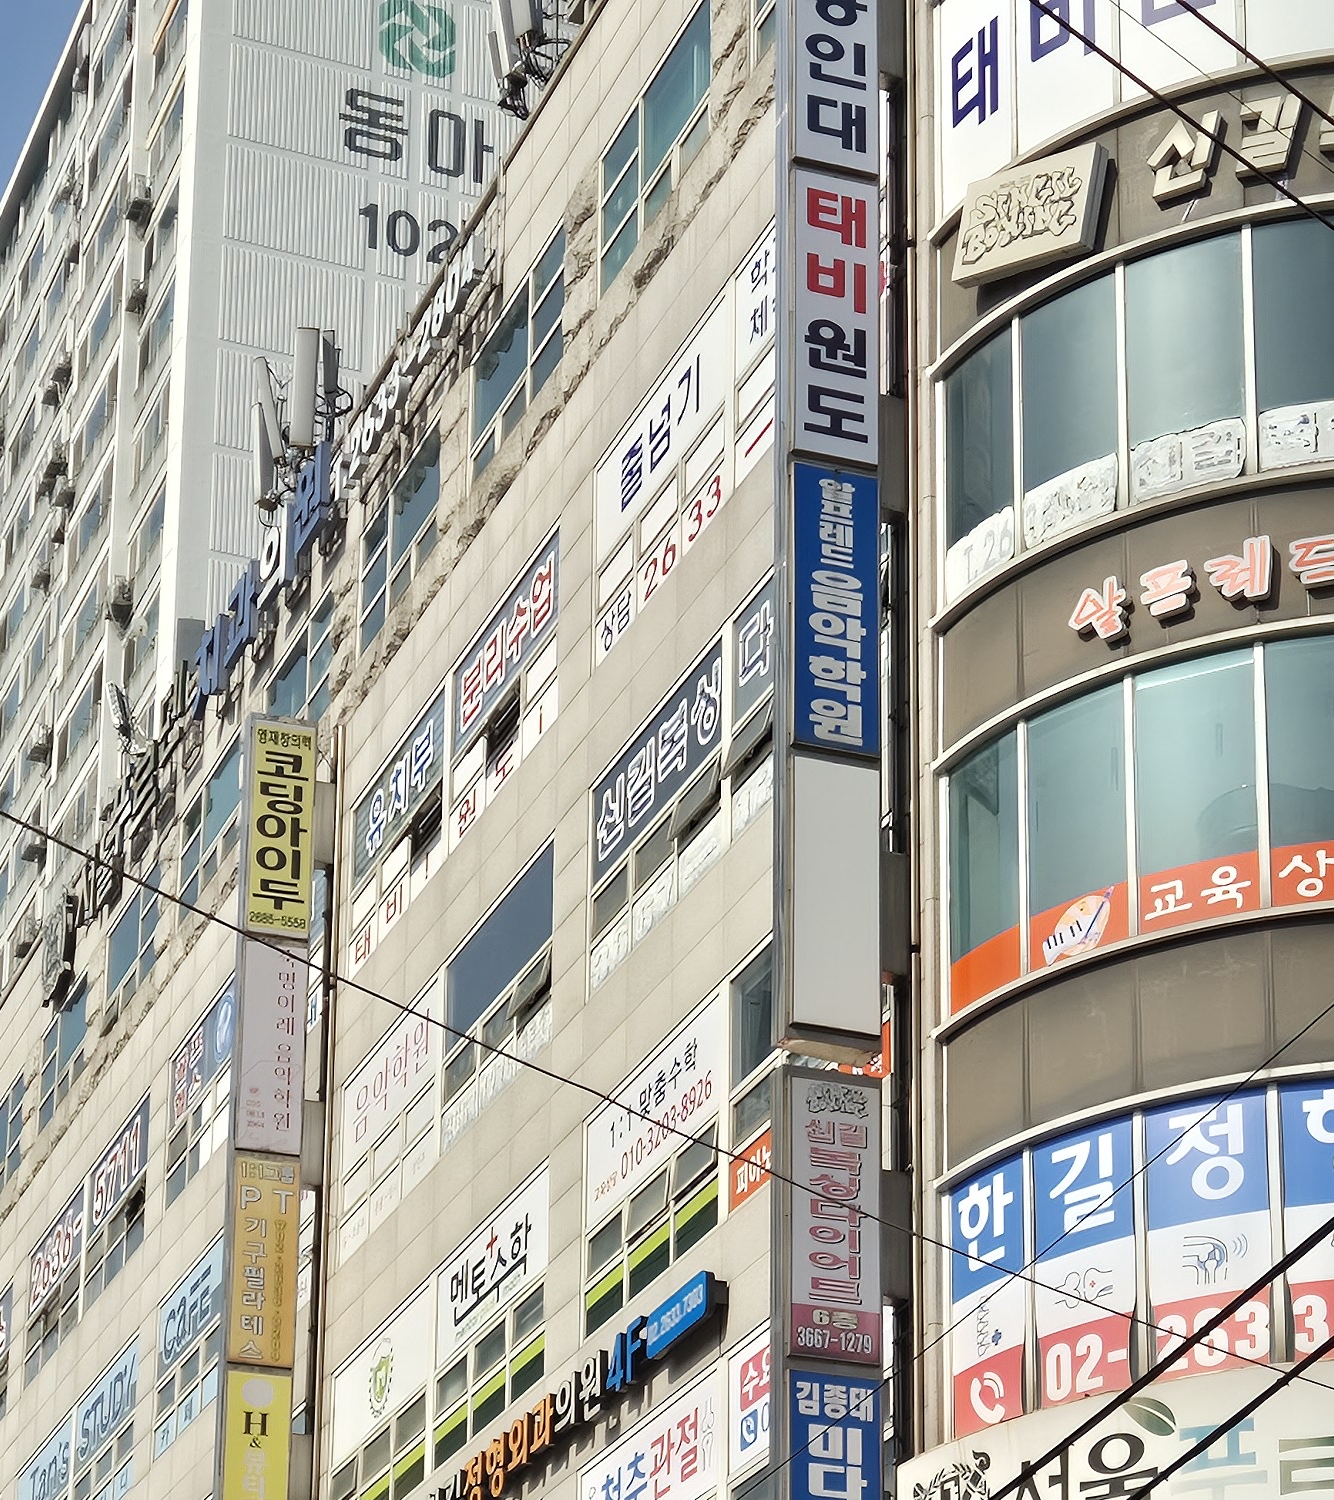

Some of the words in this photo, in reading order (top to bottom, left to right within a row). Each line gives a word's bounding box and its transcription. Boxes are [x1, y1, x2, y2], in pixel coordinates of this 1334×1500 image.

[339, 88, 494, 184] 동아
[620, 354, 701, 511] 줄넘기
[600, 590, 631, 651] 상담
[809, 570, 867, 746] 음악학원
[253, 751, 308, 911] 코딩아이두
[1145, 862, 1253, 922] 교육
[353, 1009, 430, 1143] 음악학원
[239, 1217, 266, 1360] 기구필라테스
[813, 1309, 858, 1329] 6층
[606, 1316, 646, 1392] 4F
[796, 1326, 872, 1354] 3667-1279
